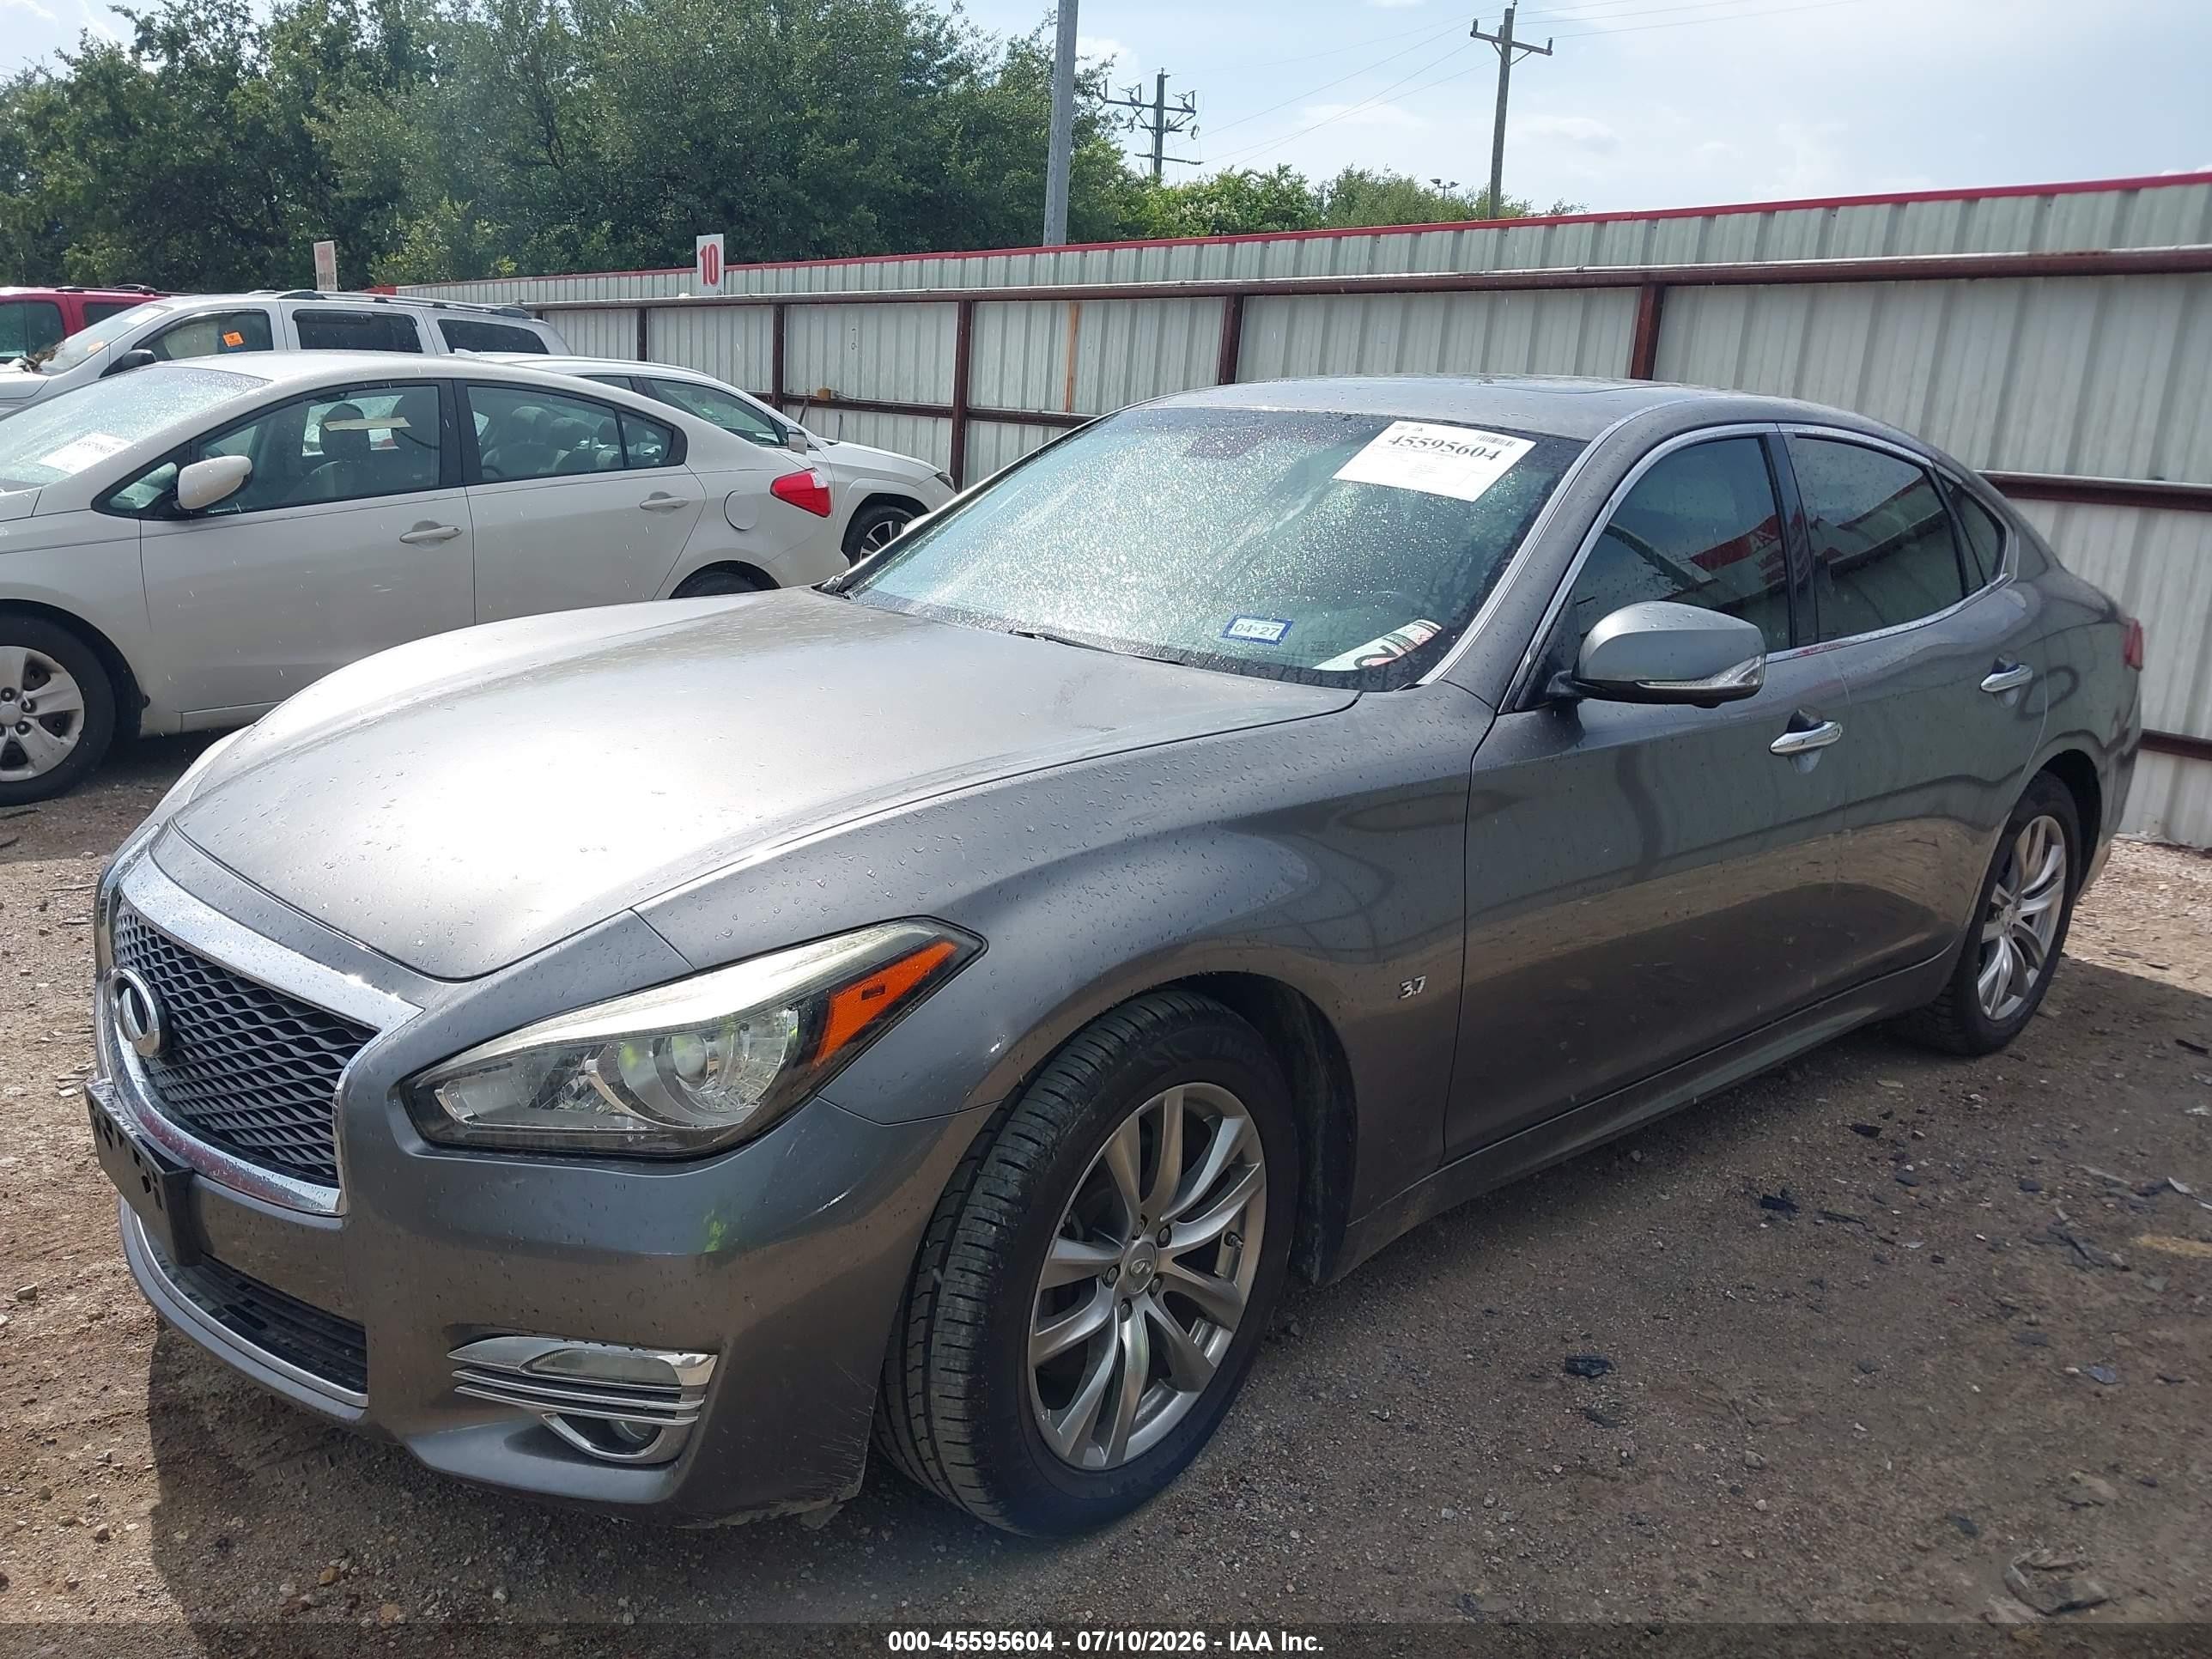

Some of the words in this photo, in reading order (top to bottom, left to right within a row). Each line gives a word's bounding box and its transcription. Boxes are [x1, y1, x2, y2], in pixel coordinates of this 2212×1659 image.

[700, 243, 720, 285] 10
[1388, 434, 1503, 461] 45595604
[1234, 623, 1254, 633] 04
[1259, 626, 1280, 636] 27
[1399, 975, 1426, 999] 3.7
